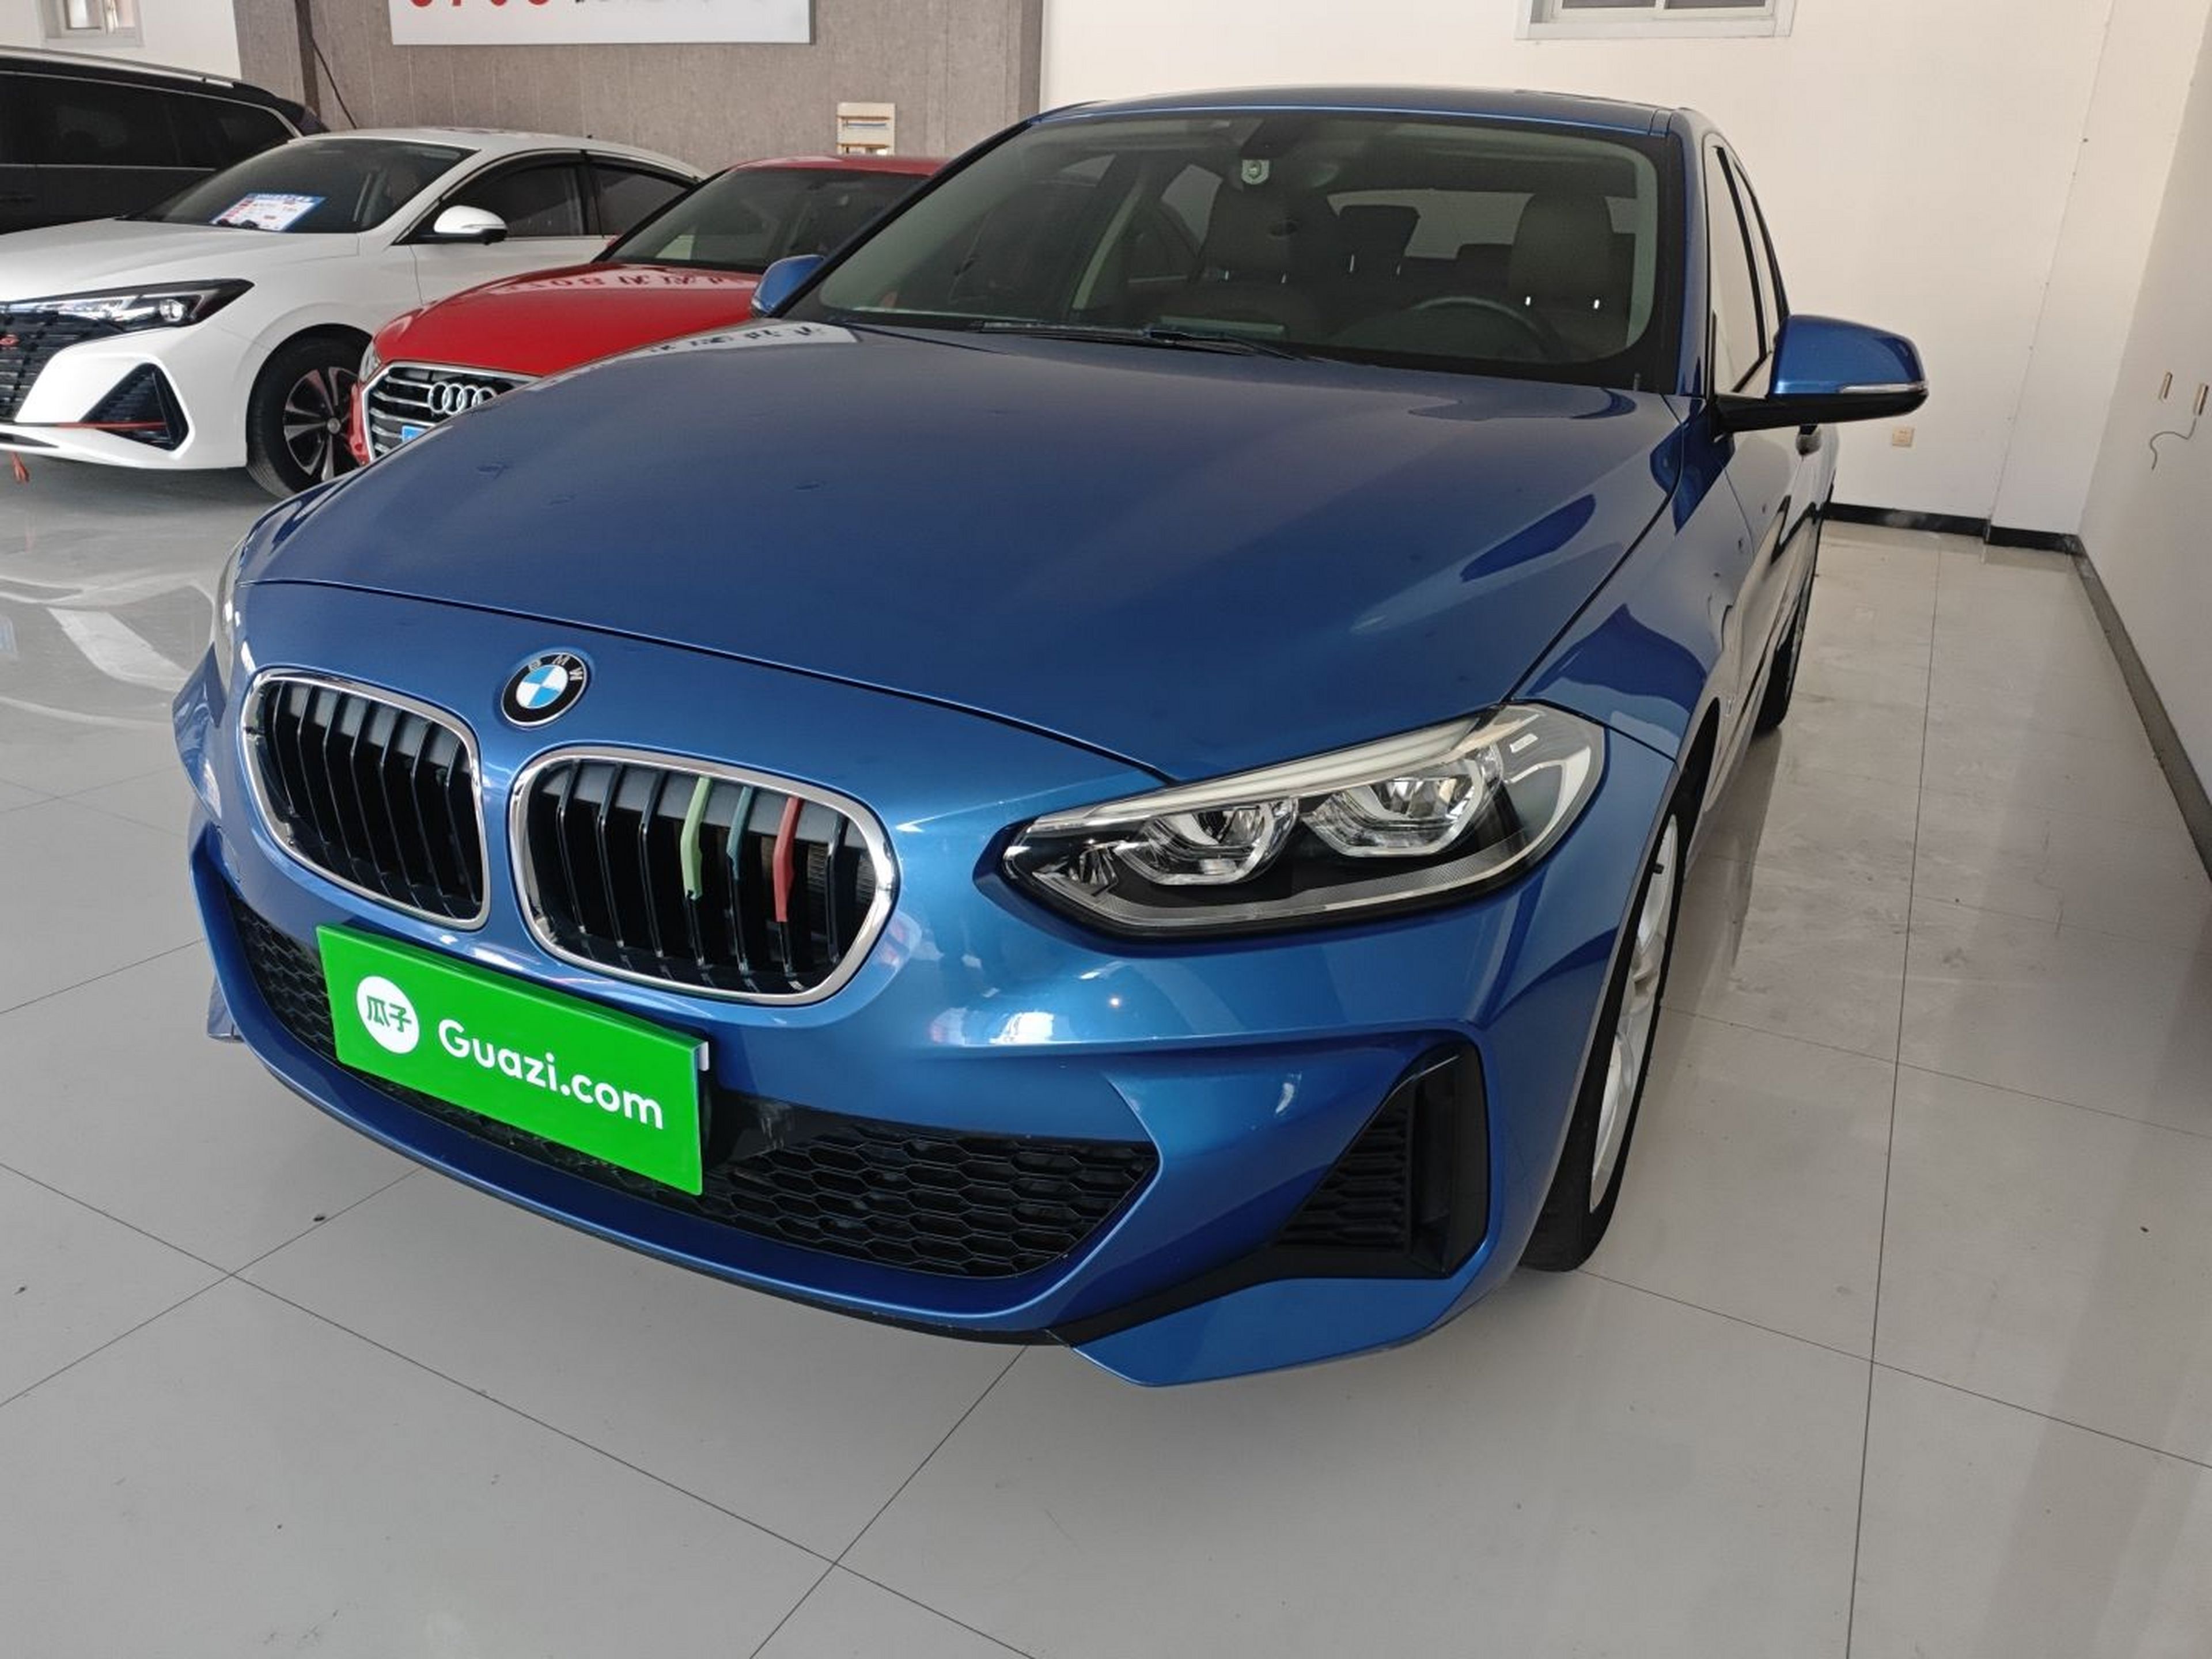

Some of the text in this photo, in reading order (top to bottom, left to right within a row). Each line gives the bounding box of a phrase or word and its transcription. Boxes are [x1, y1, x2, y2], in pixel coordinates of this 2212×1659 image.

[528, 654, 584, 681] BMW
[366, 995, 412, 1033] 瓜子
[438, 1019, 664, 1130] Guazi.com
